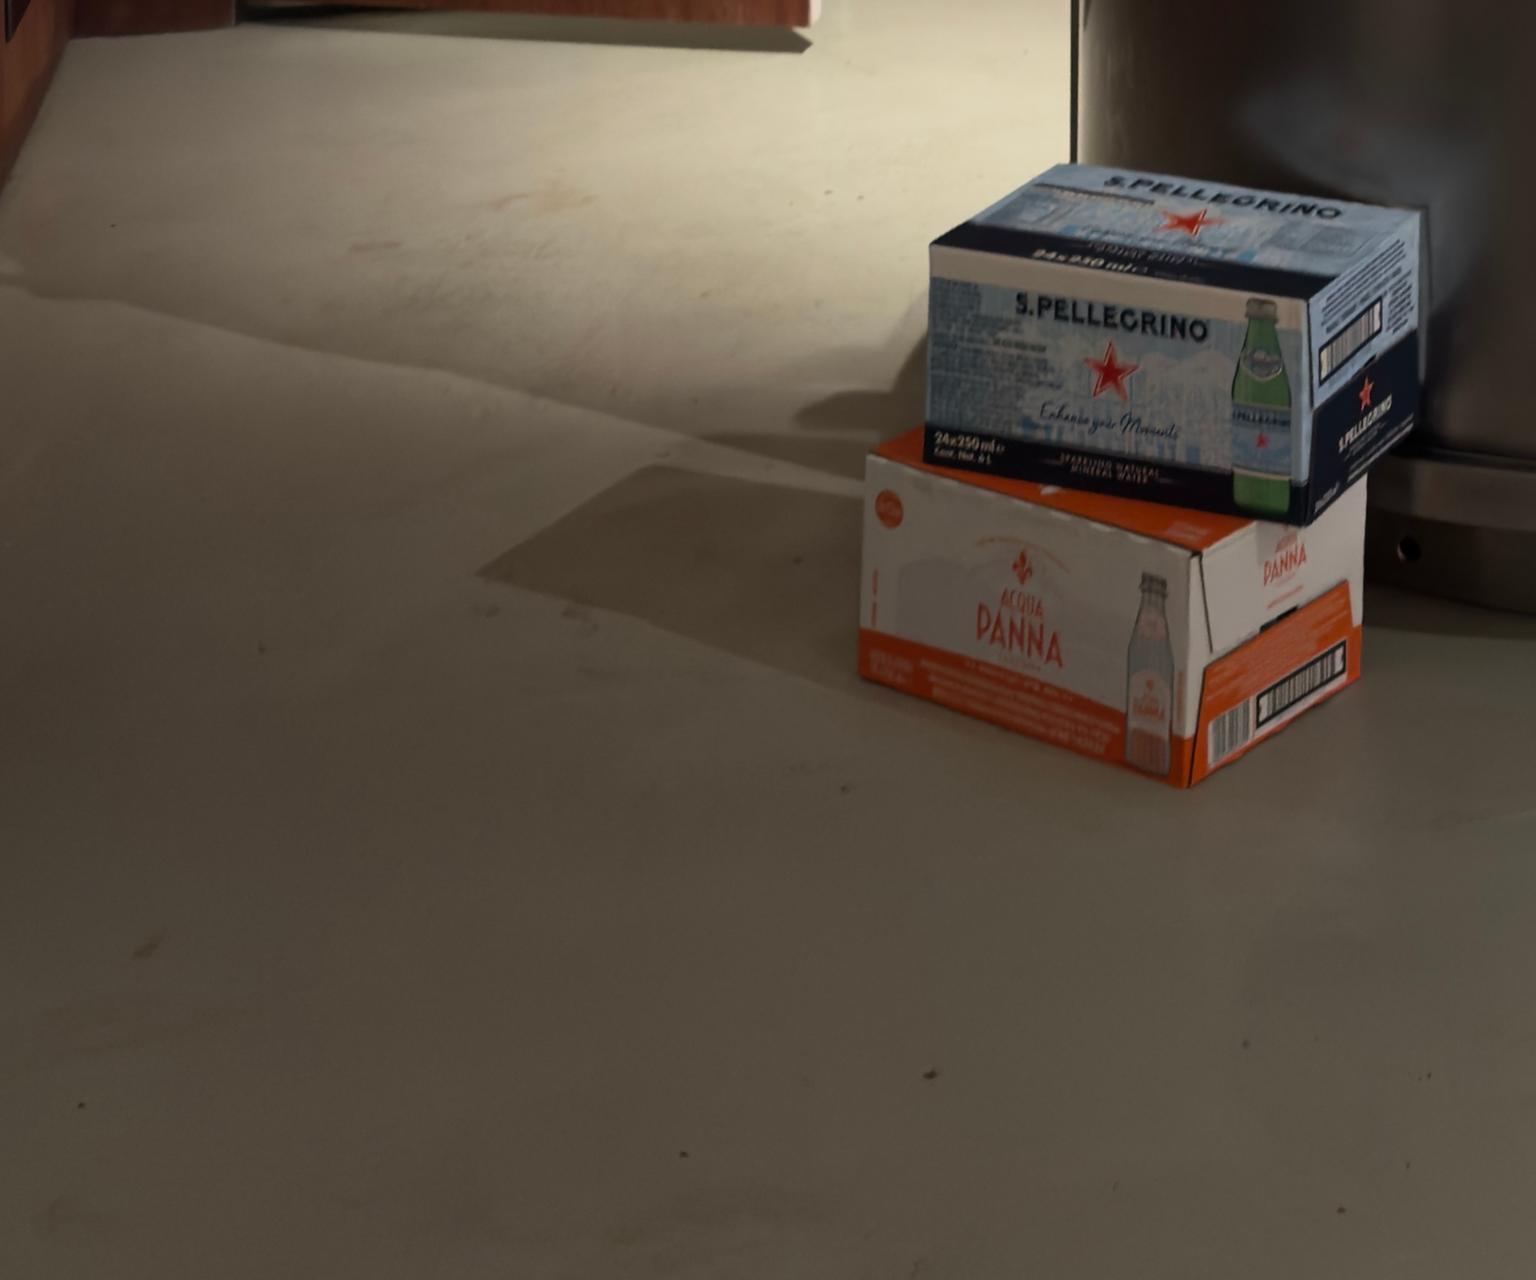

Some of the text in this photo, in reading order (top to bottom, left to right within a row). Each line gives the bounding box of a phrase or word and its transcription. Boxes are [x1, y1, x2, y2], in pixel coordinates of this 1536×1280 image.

[1104, 174, 1343, 220] S.PELLEGRINO
[1015, 291, 1209, 342] S.PELLEGRINO
[1338, 393, 1393, 454] S.PELLEGRINO
[1264, 543, 1307, 586] PANNA
[1001, 586, 1045, 617] ACQUA
[976, 600, 1064, 669] PANNA
